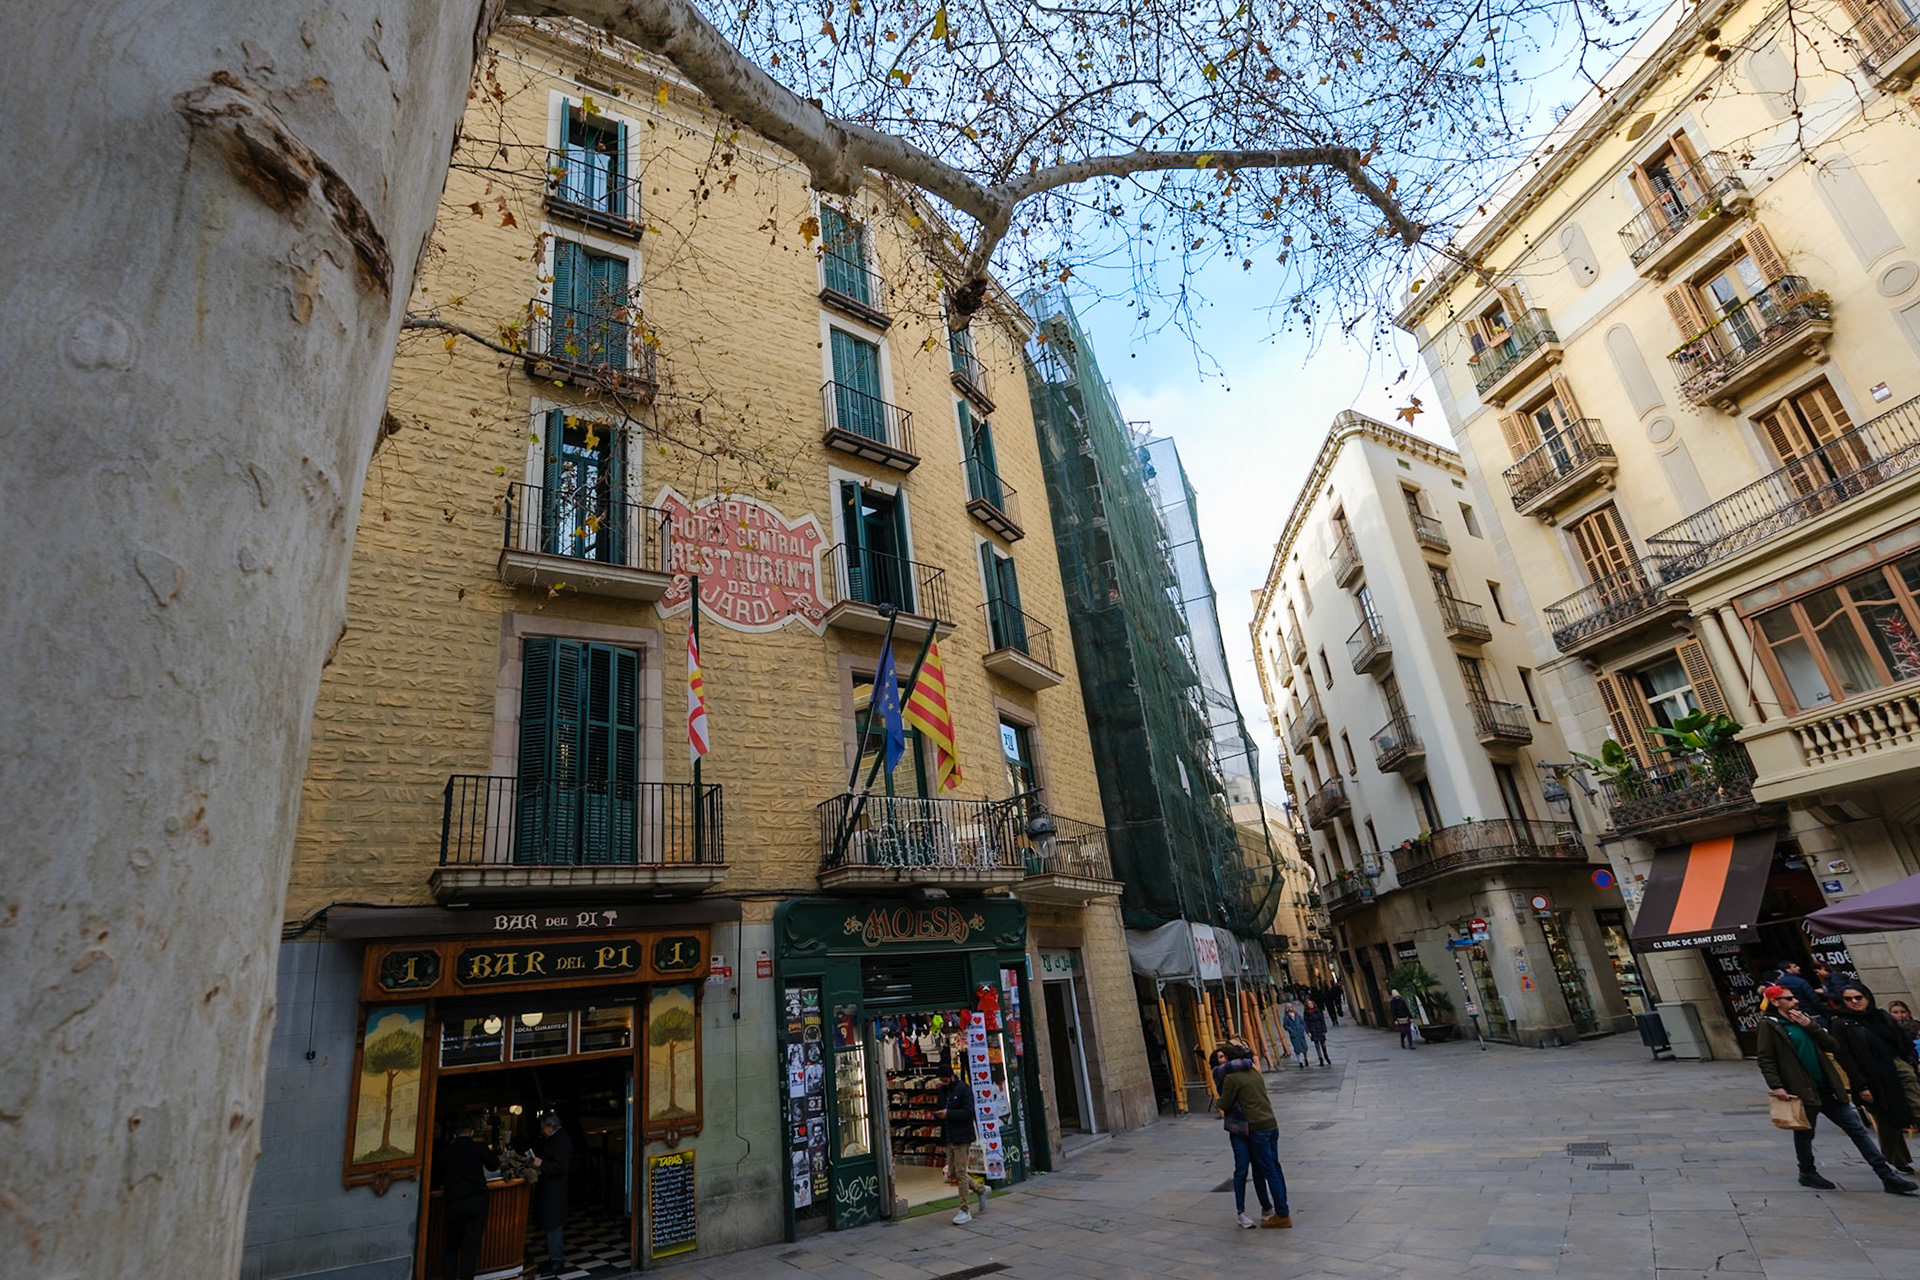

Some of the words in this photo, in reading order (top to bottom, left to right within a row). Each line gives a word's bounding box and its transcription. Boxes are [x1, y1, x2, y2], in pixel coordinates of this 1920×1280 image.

[706, 501, 779, 529] GRAN
[671, 515, 729, 545] HOTEL
[735, 527, 812, 558] CENTRAL
[670, 541, 814, 591] RESTAURANT
[727, 580, 762, 597] DEL
[493, 914, 538, 930] BAR
[577, 911, 599, 927] PI
[862, 907, 970, 947] MOLSA
[1662, 940, 1681, 949] DRAC
[1682, 938, 1693, 946] DE
[1693, 936, 1712, 945] SANT
[1713, 933, 1737, 943] JORDI
[466, 951, 547, 979] BAR
[555, 956, 586, 971] DEL
[594, 945, 634, 970] PI
[1719, 956, 1742, 972] 15€
[1728, 973, 1755, 987] TAPAS
[983, 1131, 997, 1140] 69
[658, 1155, 683, 1167] TAPAS
